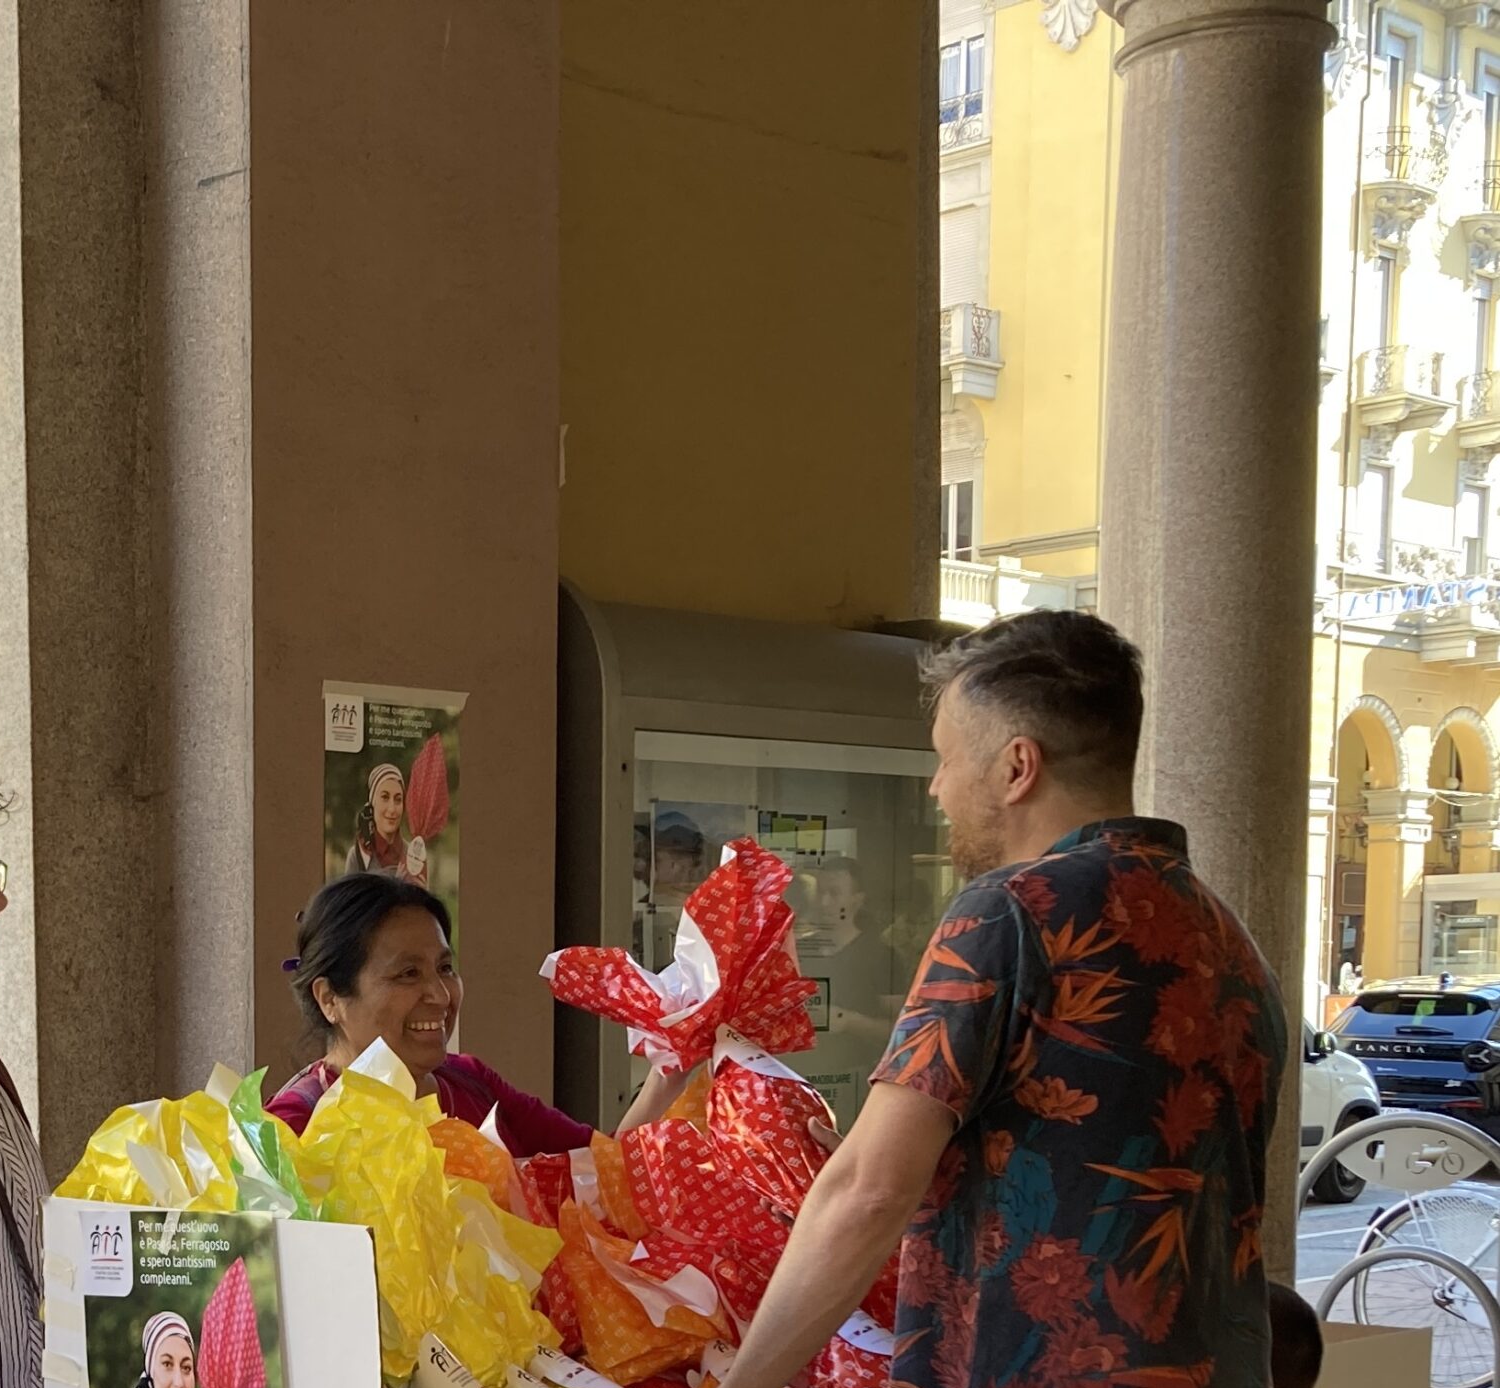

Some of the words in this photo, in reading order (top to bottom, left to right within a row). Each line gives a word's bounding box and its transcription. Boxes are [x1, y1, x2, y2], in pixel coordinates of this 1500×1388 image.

[1355, 1043, 1426, 1054] LANCIA
[139, 1220, 152, 1232] Per
[140, 1237, 145, 1249] è
[181, 1239, 229, 1253] Ferragosto
[148, 1258, 171, 1269] spero
[173, 1255, 216, 1268] tantissimi
[140, 1272, 192, 1286] compleanni.
